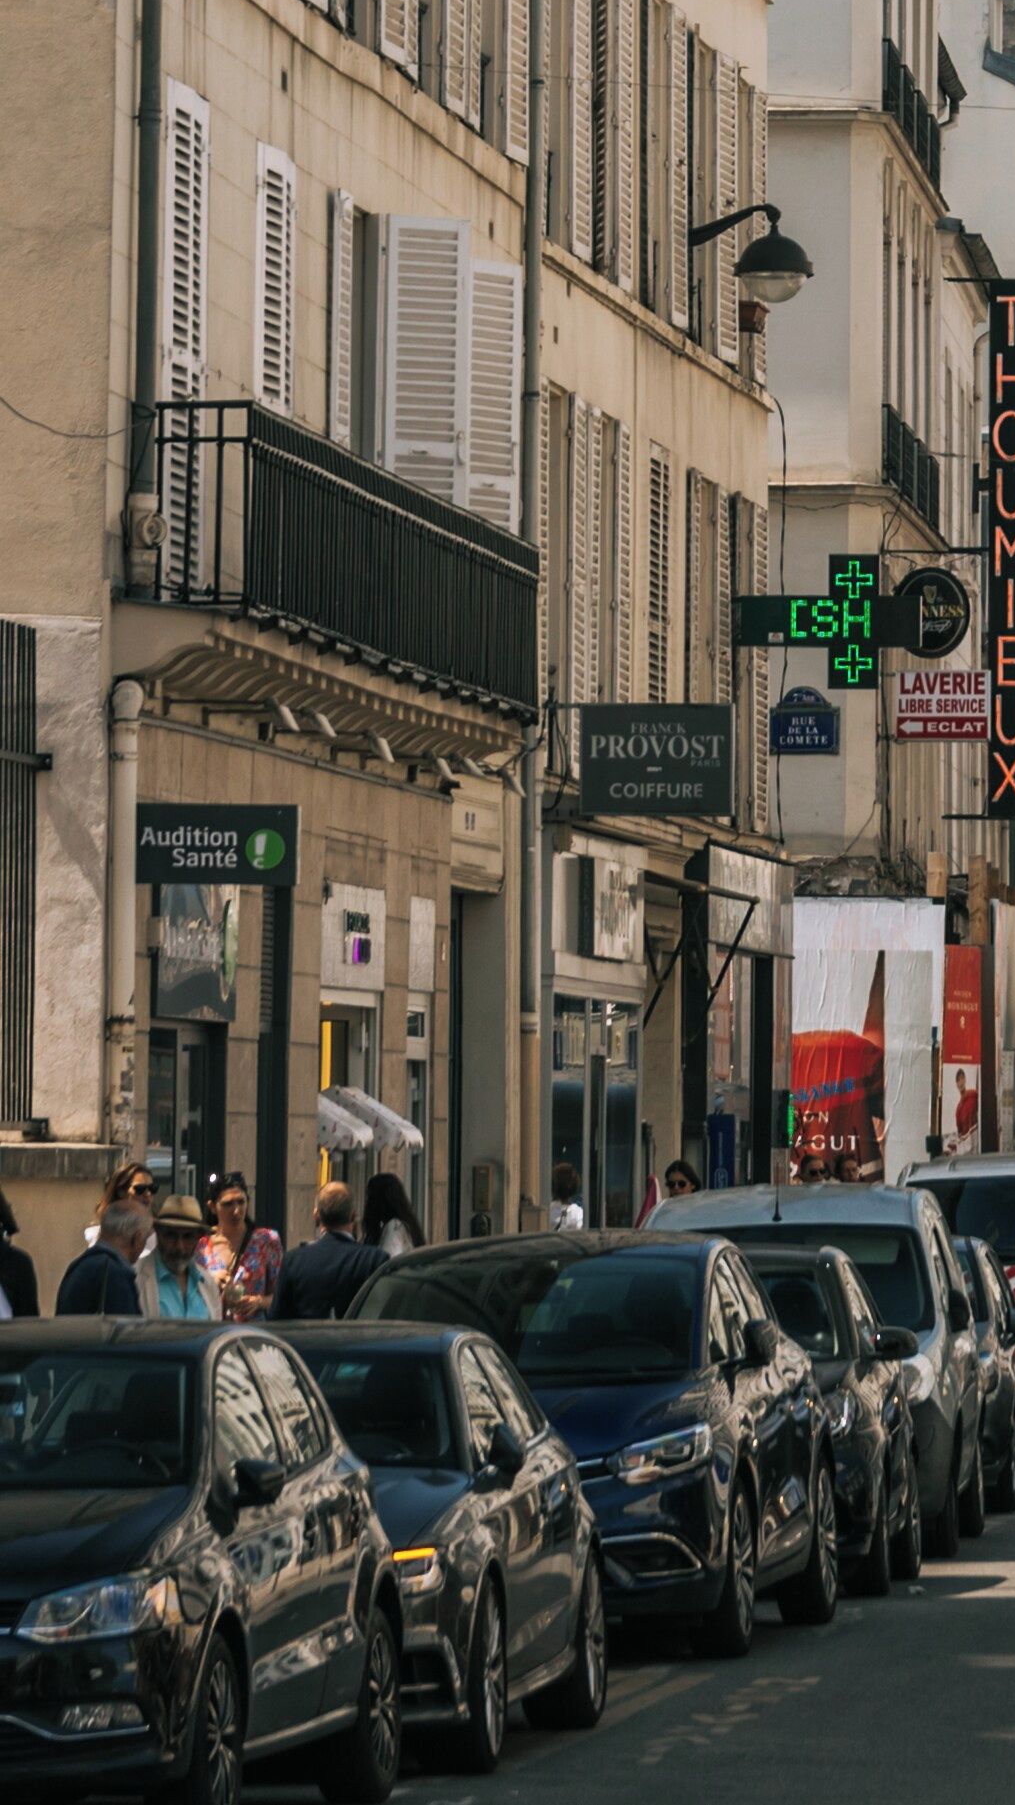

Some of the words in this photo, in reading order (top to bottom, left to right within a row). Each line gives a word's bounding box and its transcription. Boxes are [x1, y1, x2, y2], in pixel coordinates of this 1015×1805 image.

[900, 672, 985, 695] LAVERIE
[898, 698, 932, 714] LIBRE
[936, 698, 985, 714] SERVICE
[630, 722, 687, 734] FRANCK
[791, 716, 816, 725] RUE
[926, 722, 985, 733] ECLAT
[788, 726, 801, 734] DE
[806, 726, 818, 734] LA
[590, 734, 725, 759] PROVOST
[690, 759, 721, 767] PARIS
[609, 782, 703, 798] COIFFURE
[140, 826, 238, 846] Audition
[172, 848, 238, 868] Santé
